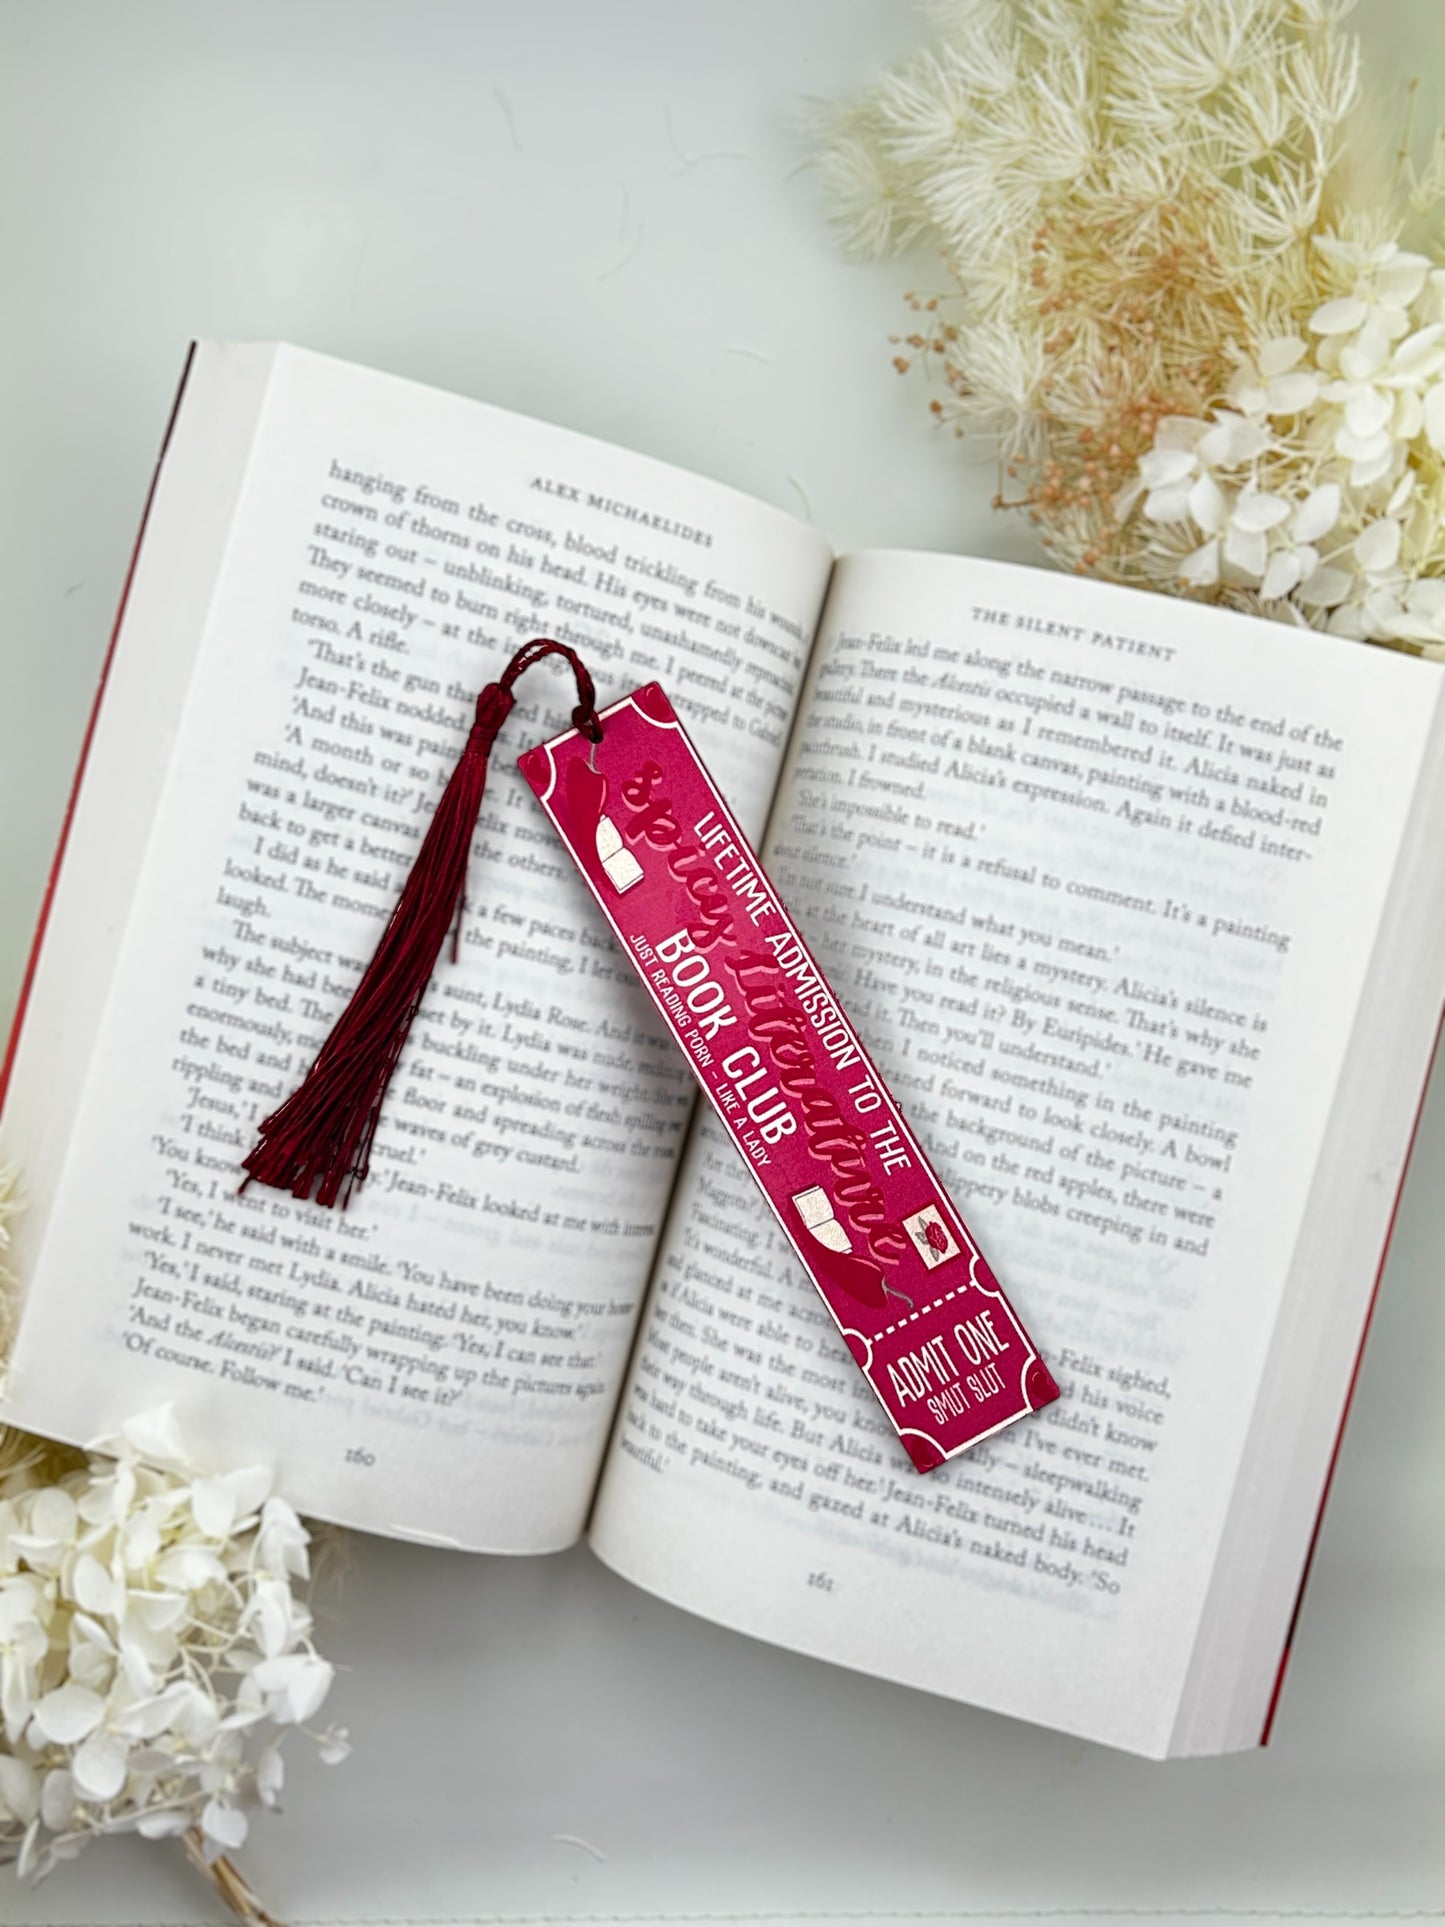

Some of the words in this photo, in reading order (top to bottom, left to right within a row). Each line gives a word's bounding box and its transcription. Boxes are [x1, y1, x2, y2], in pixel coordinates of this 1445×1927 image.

[320, 493, 378, 522] crown
[383, 510, 410, 529] of
[410, 516, 470, 549] thorns
[475, 540, 500, 559] on
[505, 543, 534, 569] his
[593, 570, 627, 598] His
[631, 589, 668, 612] eyes
[673, 602, 712, 628] were
[714, 619, 741, 639] not
[328, 458, 407, 504] hanging
[413, 484, 460, 515] from
[467, 502, 499, 527] the
[563, 530, 618, 564] blood
[623, 554, 698, 597] trickling
[703, 579, 741, 609] from
[744, 595, 765, 619] his
[529, 476, 580, 502] ALEX
[586, 493, 712, 548] MICHAELIDES
[307, 543, 352, 579] They
[355, 566, 426, 597] seemed
[429, 586, 450, 605] to
[454, 589, 498, 620] burn
[503, 608, 550, 634] right
[554, 621, 624, 660] through
[664, 655, 675, 675] I
[675, 666, 729, 694] peered
[312, 522, 379, 558] staring
[384, 544, 418, 564] out
[639, 622, 743, 673] unashamedly
[344, 619, 362, 641] A
[971, 606, 1010, 626] THE
[1014, 615, 1085, 641] SILENT
[1090, 630, 1176, 661] PATIENT
[370, 658, 401, 682] the
[402, 673, 440, 694] gun
[903, 637, 931, 658] led
[931, 647, 960, 663] me
[962, 648, 1013, 678] along
[1015, 658, 1046, 680] the
[1049, 670, 1115, 694] narrow
[1115, 685, 1186, 716] passage
[1190, 701, 1211, 718] to
[1214, 704, 1245, 727] the
[1248, 717, 1286, 737] end
[1287, 724, 1313, 743] of
[1312, 725, 1343, 751] the
[866, 719, 883, 735] in
[885, 718, 927, 743] front
[929, 728, 952, 748] of
[951, 730, 963, 751] a
[966, 734, 1016, 763] blank
[1085, 767, 1165, 802] painting
[1168, 785, 1210, 809] with
[1213, 798, 1225, 813] a
[1229, 796, 1322, 836] blood-red
[994, 687, 1076, 716] occupied
[1078, 706, 1091, 720] a
[1095, 709, 1134, 730] wall
[1138, 718, 1158, 735] to
[1216, 732, 1235, 755] It
[1238, 743, 1273, 764] was
[1273, 749, 1312, 774] just
[1315, 763, 1335, 779] as
[655, 928, 737, 1040] BOOK
[722, 1046, 796, 1143] CLUB
[694, 811, 774, 926] LIFETIME
[765, 932, 860, 1070] ADMISSION
[848, 1074, 881, 1112] TO
[870, 1120, 911, 1175] THE
[630, 935, 657, 965] JUST
[651, 968, 691, 1026] READING
[685, 1029, 713, 1066] PORN
[716, 1083, 738, 1112] LIKE
[733, 1117, 746, 1128] A
[743, 1130, 770, 1165] LADY
[939, 1078, 1013, 1114] forward
[1017, 1103, 1037, 1120] to
[1042, 1105, 1084, 1134] look
[1159, 1138, 1177, 1159] A
[1183, 1143, 1232, 1173] bowl
[180, 1230, 192, 1250] I
[194, 1241, 244, 1265] never
[247, 1256, 284, 1276] met
[346, 1278, 400, 1308] Alicia
[404, 1291, 457, 1320] hated
[493, 1317, 527, 1335] you
[212, 1211, 236, 1234] he
[239, 1224, 286, 1247] said
[283, 1234, 321, 1257] with
[323, 1247, 336, 1261] a
[437, 1270, 480, 1297] have
[482, 1280, 524, 1306] been
[526, 1290, 574, 1318] doing
[574, 1301, 606, 1319] your
[130, 1276, 225, 1319] Jean-Felix
[227, 1303, 281, 1334] began
[284, 1325, 362, 1360] carefully
[365, 1345, 450, 1382] wrapping
[453, 1366, 477, 1387] up
[481, 1367, 510, 1388] the
[511, 1374, 572, 1396] pictures
[219, 1358, 281, 1391] Follow
[887, 1335, 959, 1406] ADMIT
[953, 1309, 1009, 1364] ONE
[927, 1382, 969, 1424] SMUT
[966, 1362, 1005, 1401] SLUT
[344, 1446, 376, 1467] 160
[664, 1431, 687, 1454] the
[768, 1478, 804, 1500] and
[807, 1492, 864, 1520] gazed
[869, 1511, 889, 1528] at
[968, 1540, 1028, 1568] naked
[695, 1417, 728, 1442] take
[728, 1433, 770, 1458] your
[771, 1449, 808, 1472] eyes
[812, 1461, 844, 1482] off
[881, 1479, 979, 1524] Jean-Felix
[982, 1511, 1046, 1542] turned
[1047, 1526, 1078, 1552] his
[1081, 1536, 1129, 1567] head
[806, 1571, 834, 1592] 161
